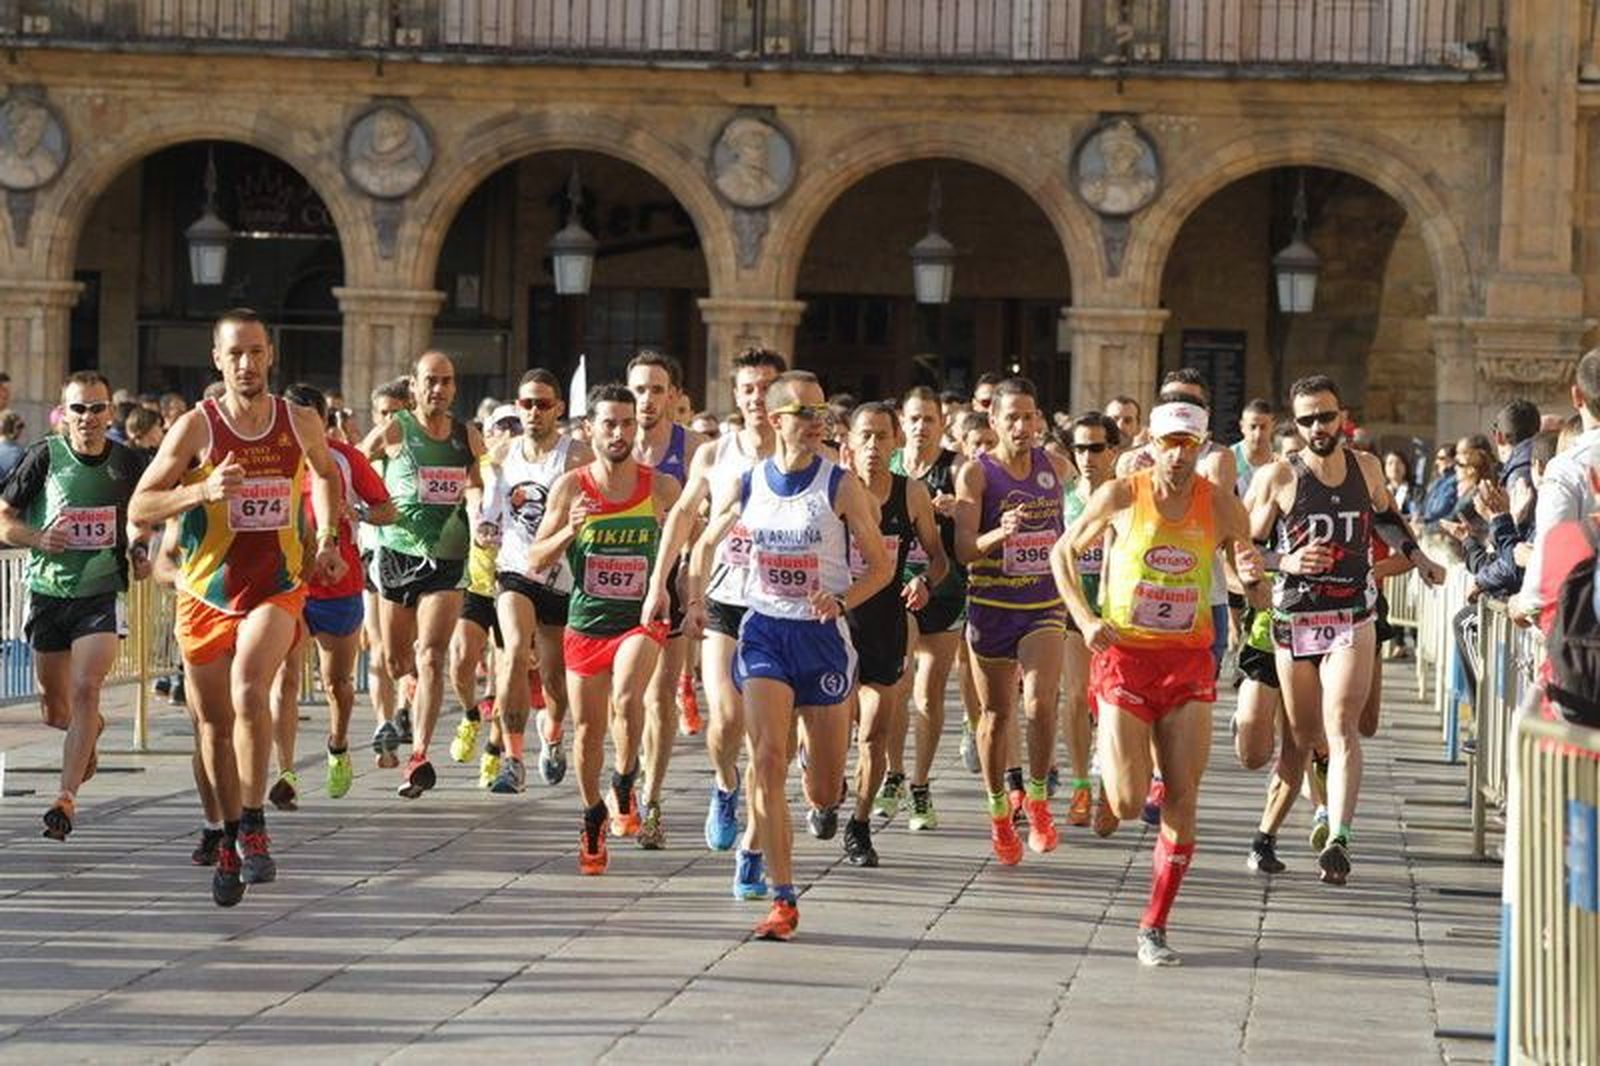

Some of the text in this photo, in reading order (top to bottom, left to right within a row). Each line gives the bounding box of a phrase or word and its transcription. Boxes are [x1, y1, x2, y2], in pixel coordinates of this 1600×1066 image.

[429, 480, 458, 493] 245
[242, 499, 281, 516] 674
[72, 522, 106, 537] 113
[768, 525, 823, 546] ARMUÑA
[731, 537, 753, 554] 27
[1016, 547, 1049, 563] 396
[597, 571, 634, 587] 567
[768, 569, 807, 586] 599
[1157, 602, 1172, 618] 2
[1311, 625, 1336, 641] 70
